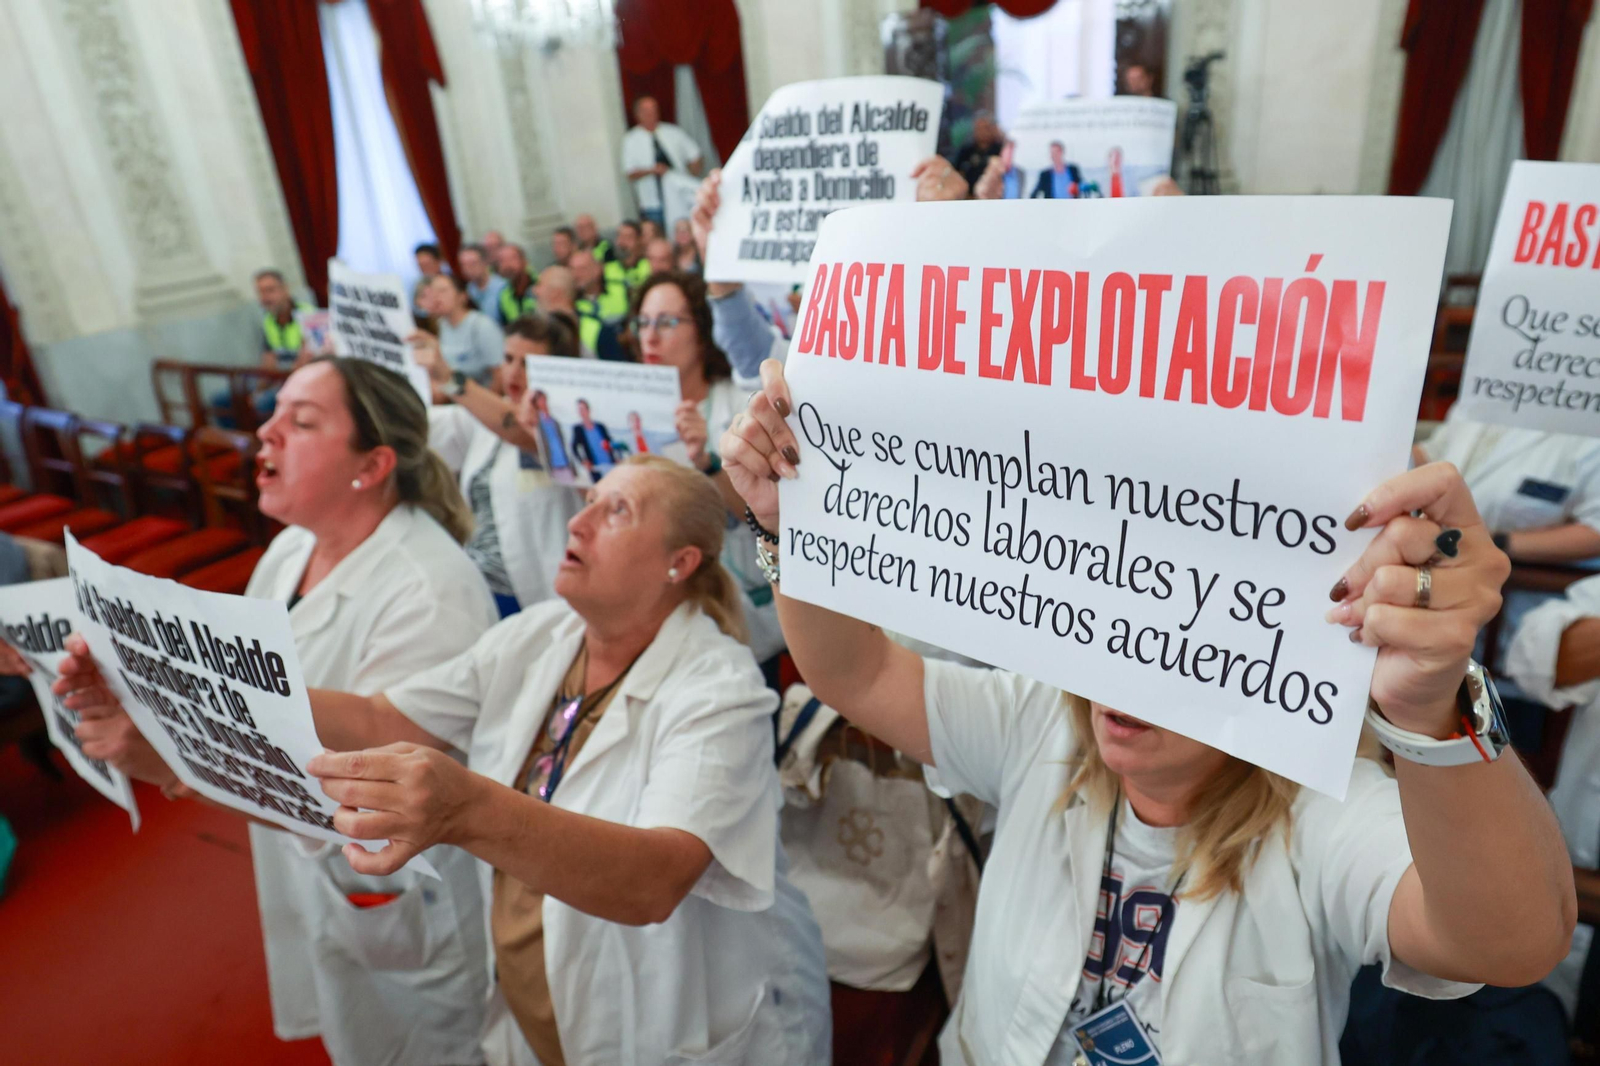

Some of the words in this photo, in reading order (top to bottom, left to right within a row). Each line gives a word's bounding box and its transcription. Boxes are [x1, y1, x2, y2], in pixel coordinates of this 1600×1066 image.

[818, 103, 843, 135] del
[851, 100, 928, 133] Alcalde
[857, 138, 878, 166] de
[742, 175, 793, 204] Ayuda
[799, 178, 808, 201] a
[814, 171, 895, 200] Domicilio
[750, 209, 770, 234] ya
[798, 262, 907, 368] BASTA
[918, 264, 970, 375] DE
[979, 253, 1387, 422] EXPLOTACIÓN
[1502, 294, 1569, 342] Que
[798, 402, 866, 471] Que
[872, 431, 906, 467] se
[914, 430, 1094, 509] cumplan
[1104, 478, 1338, 556] nuestros
[823, 460, 971, 548] derechos
[983, 489, 1175, 601] laborales
[1179, 567, 1220, 632] y
[1229, 580, 1286, 630] se
[787, 525, 919, 588] respeten
[928, 565, 1096, 646] nuestros
[1106, 629, 1339, 726] acuerdos
[152, 610, 198, 665] del
[189, 620, 292, 697] Alcalde
[217, 677, 257, 729] de
